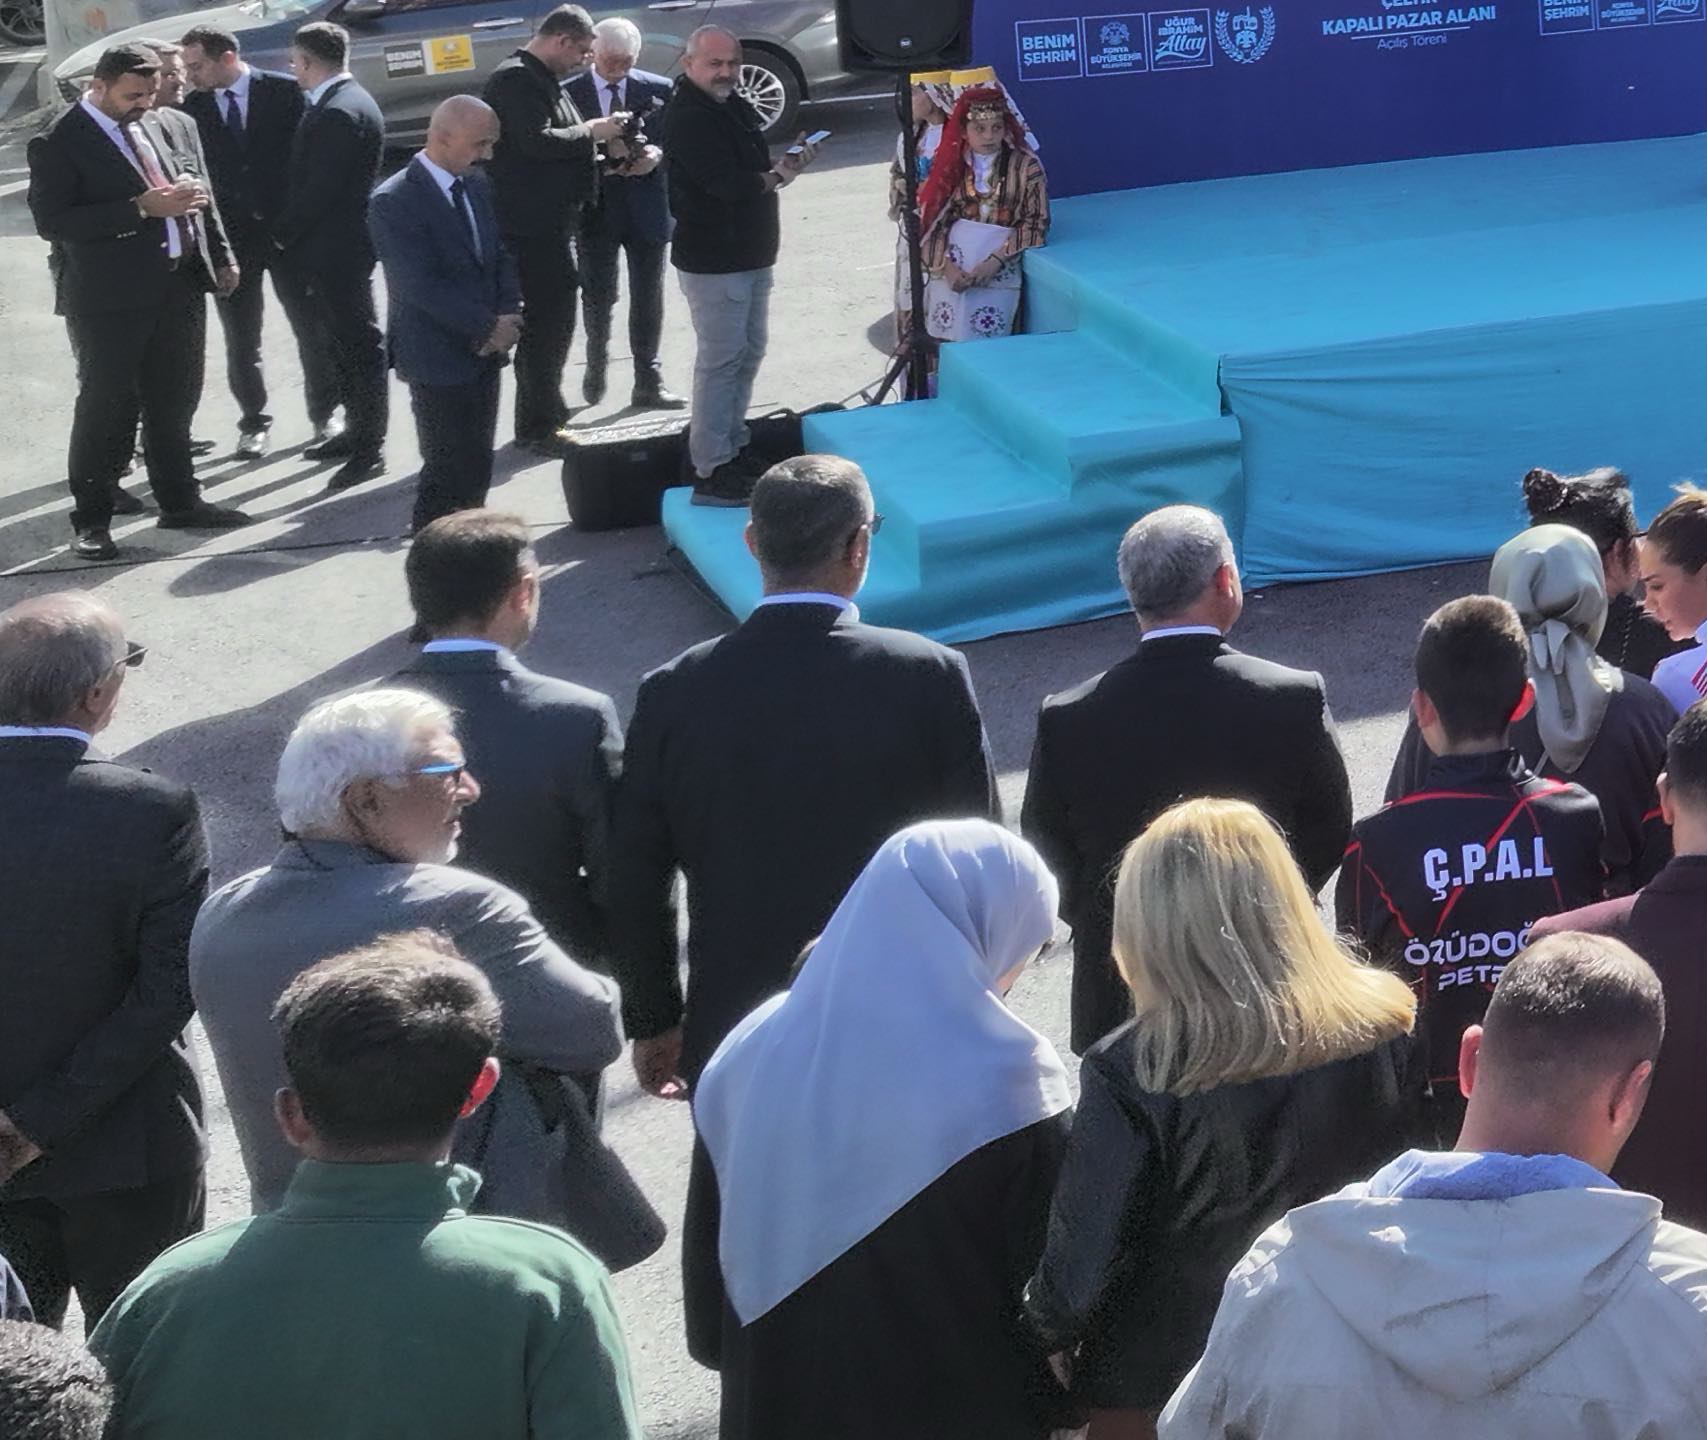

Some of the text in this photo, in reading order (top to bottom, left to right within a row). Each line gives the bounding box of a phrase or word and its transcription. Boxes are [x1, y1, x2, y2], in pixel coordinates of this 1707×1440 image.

[1322, 6, 1496, 35] KAPALI PAZAR ALANI
[1023, 33, 1075, 50] BENİM
[1023, 49, 1075, 65] ŞEHRİM
[1423, 836, 1553, 902] Ç.P.A.L
[1404, 921, 1533, 966] ÖZÜDOĞ
[1438, 964, 1502, 991] PETR
